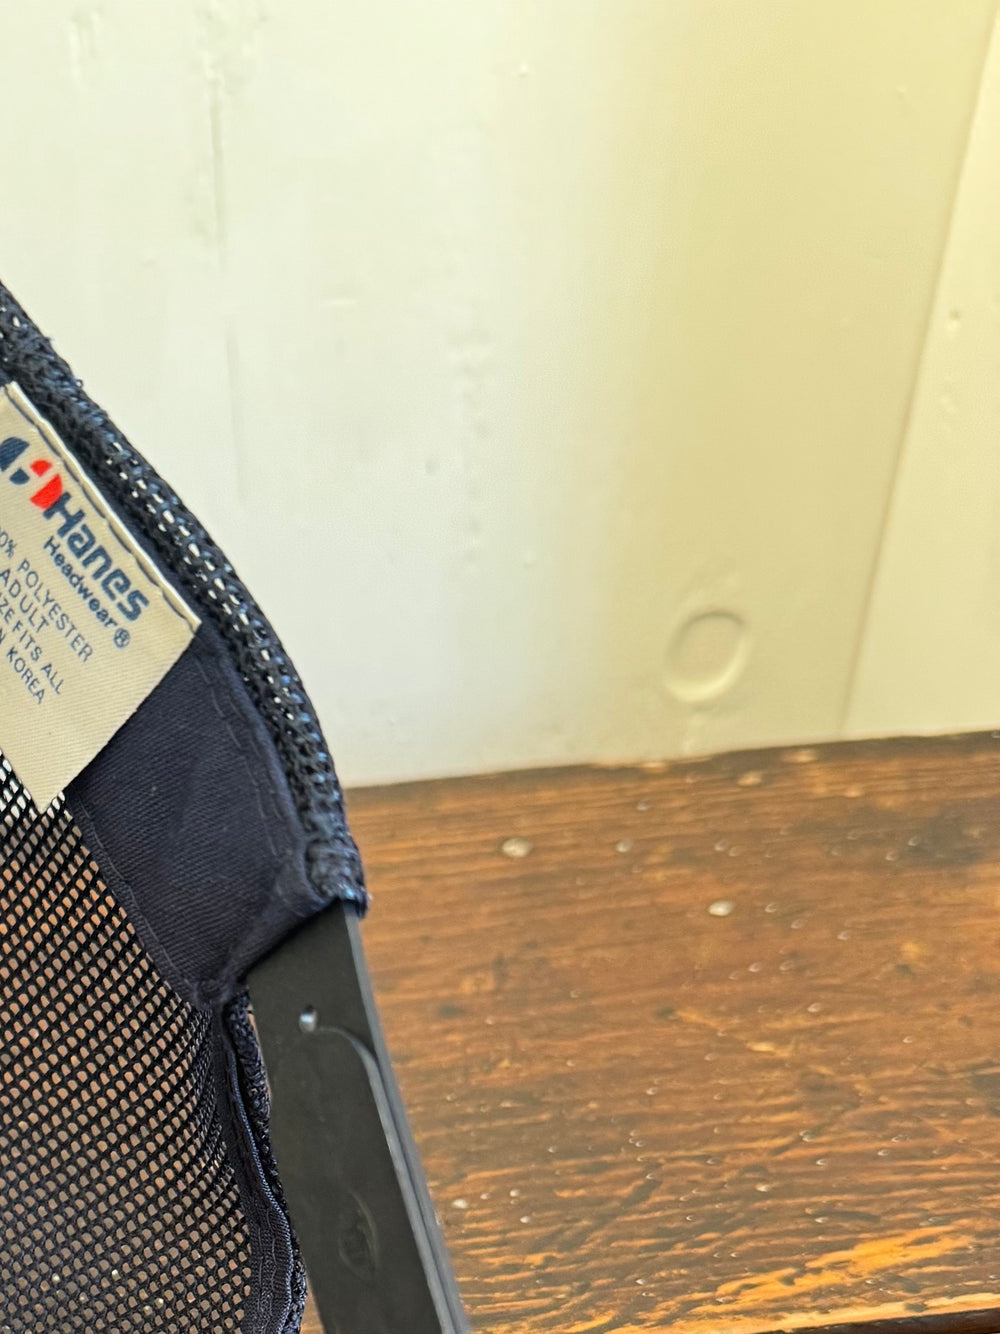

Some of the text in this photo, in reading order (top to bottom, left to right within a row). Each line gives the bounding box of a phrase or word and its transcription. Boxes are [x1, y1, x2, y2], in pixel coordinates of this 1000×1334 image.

[43, 493, 150, 625] Hanes
[17, 560, 94, 663] POLYESTER
[7, 647, 46, 705] KOREA
[12, 621, 42, 663] FITS
[41, 662, 64, 696] ALL
